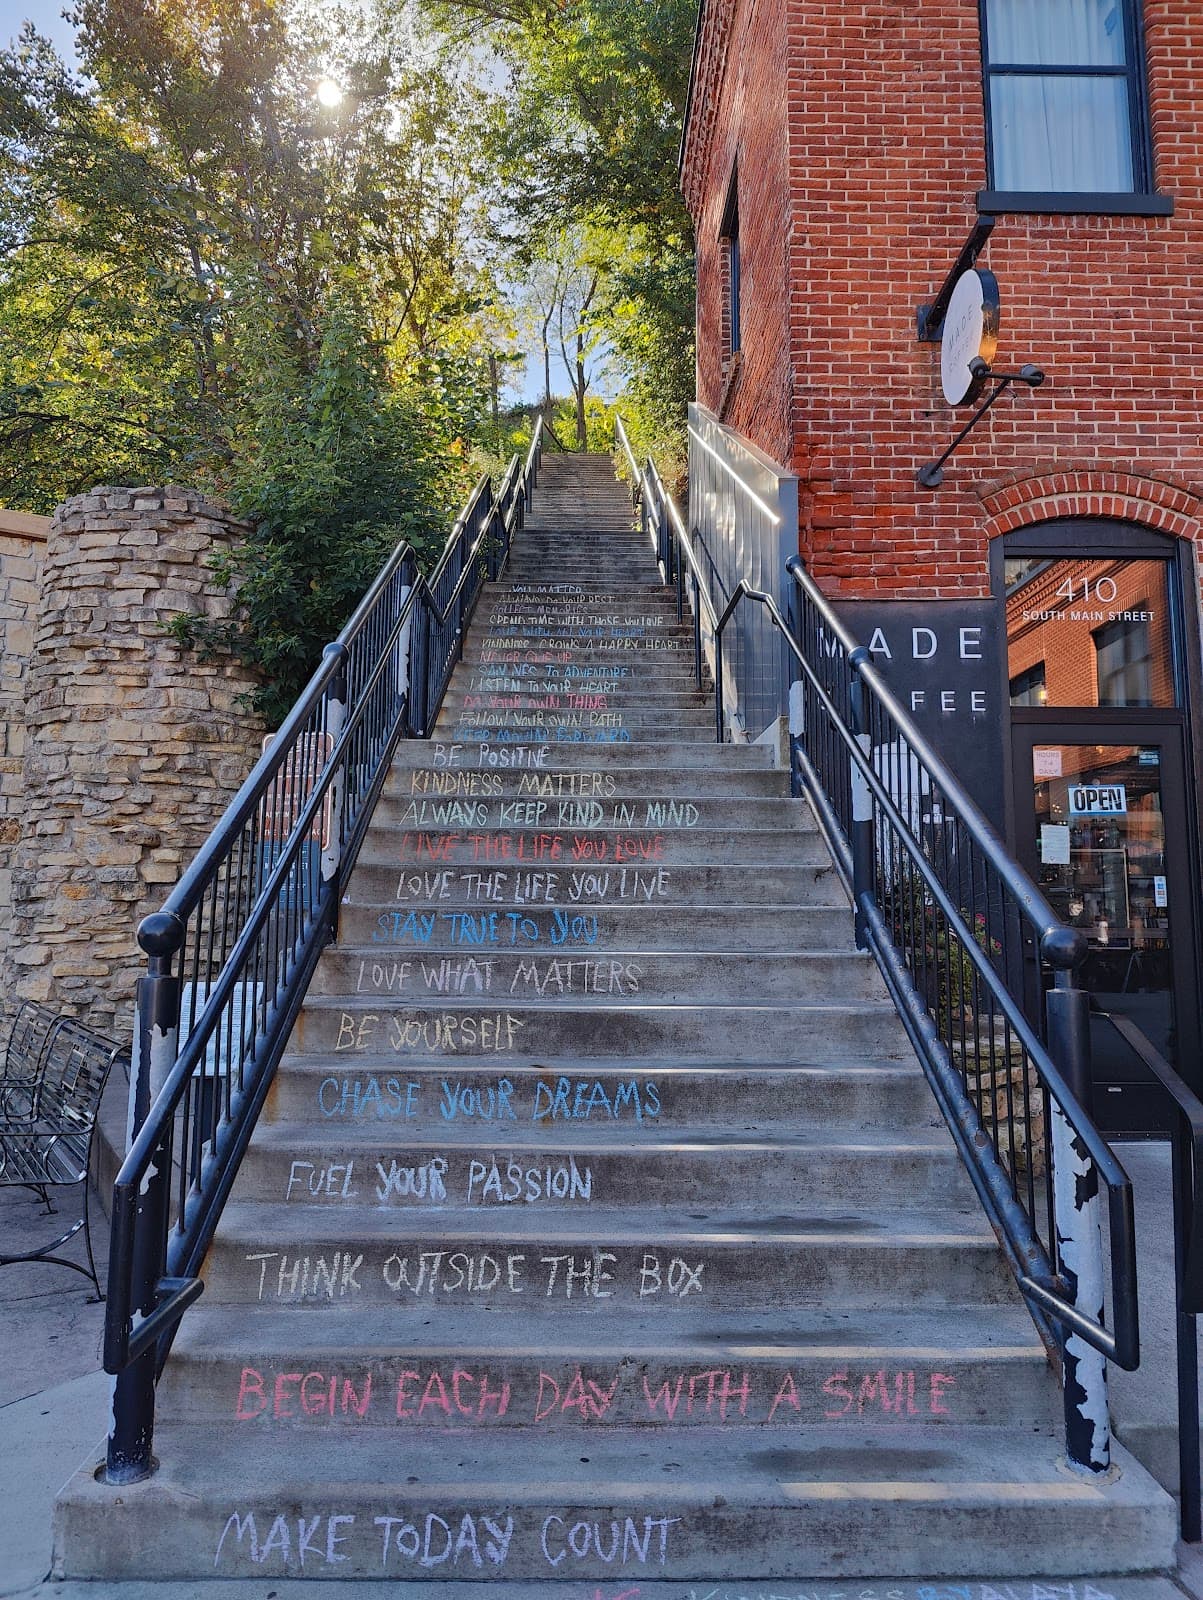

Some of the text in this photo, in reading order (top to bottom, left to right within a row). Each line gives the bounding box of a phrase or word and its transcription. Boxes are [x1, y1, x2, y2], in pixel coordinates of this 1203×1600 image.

[1056, 577, 1117, 602] 410
[489, 614, 526, 624] SPEND
[528, 614, 554, 624] TIME
[558, 615, 584, 625] WITH
[588, 615, 620, 625] THOSE
[492, 604, 588, 614] COLLECT MEMORIES
[1022, 610, 1155, 621] SOUTH MAIN STREET
[523, 626, 550, 636] WITH
[611, 627, 645, 637] HEART
[586, 638, 593, 649] A
[600, 638, 639, 650] HAPPY
[646, 639, 680, 650] HEART
[817, 627, 982, 659] MADE
[479, 664, 508, 676] SAY
[512, 663, 538, 676] YES
[544, 664, 559, 676] TO
[558, 652, 572, 662] UP
[470, 678, 619, 694] LISTEN TO YOUR HEART
[489, 694, 521, 708] YOUR
[528, 694, 560, 708] OWN
[566, 692, 608, 709] THING
[460, 710, 622, 727] FOLLOW YOUR OWN PATH
[557, 726, 630, 742] FORWARD
[434, 742, 550, 768] BE POSITIVE
[411, 770, 617, 797] KINDNESS MATTERS
[1074, 788, 1123, 811] OPEN
[400, 800, 700, 828] ALWAYS KEEP KIND IN MIND
[400, 832, 667, 862] LIVE THE LIFE YOU LOVE
[396, 866, 671, 904] LOVE THE LIFE YOU LIVE
[373, 908, 598, 946] STAY TRUE TO YOU
[356, 958, 643, 998] LOVE WHAT MATTERS
[335, 1012, 524, 1051] BE YOURSELF
[318, 1076, 662, 1123] CHASE YOUR DREAMS
[286, 1154, 592, 1202] FUEL YOUR PASSION
[246, 1251, 705, 1300] THINK OUTSIDE THE BOX
[236, 1364, 955, 1423] BEGIN EACH DAY WITH A SMILE
[214, 1511, 682, 1568] MAKE TODAY COUNT
